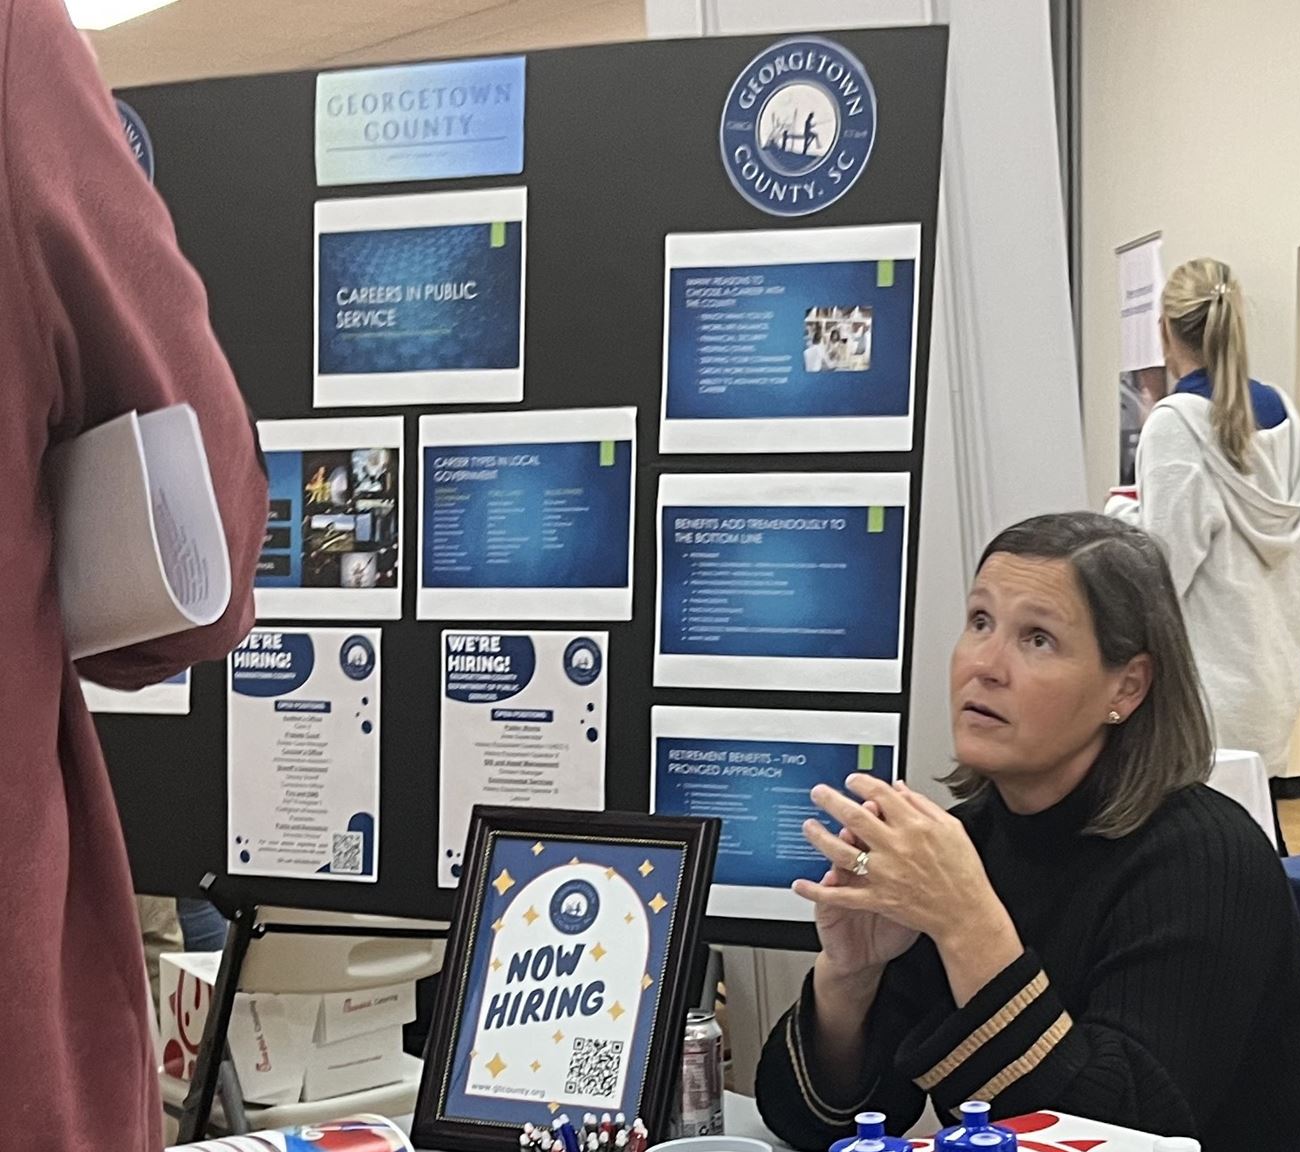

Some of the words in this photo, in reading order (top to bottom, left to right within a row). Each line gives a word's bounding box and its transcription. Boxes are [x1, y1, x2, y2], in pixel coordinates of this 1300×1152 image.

[738, 50, 864, 117] GEORGETOWN
[327, 83, 512, 117] GEORGETOWN
[364, 114, 473, 142] COUNTY
[828, 150, 855, 184] SC
[336, 286, 402, 306] CAREERS
[405, 284, 421, 301] IN
[424, 280, 479, 301] PUBLIC
[336, 308, 397, 329] SERVICE
[675, 518, 720, 530] BENEFITS
[721, 518, 746, 530] ADD
[830, 518, 847, 530] TO
[675, 532, 693, 543] THE
[694, 532, 739, 544] BOTTOM
[447, 636, 501, 653] WE'RE
[234, 652, 292, 669] HIRING!
[447, 655, 511, 672] HIRING!
[669, 749, 726, 762] RETIREMENT
[728, 752, 771, 764] BENEFITS
[782, 754, 807, 765] TWO
[668, 763, 720, 775] PRONGED
[722, 766, 784, 778] APPROACH
[506, 943, 587, 985] NOW
[484, 981, 605, 1030] HIRING
